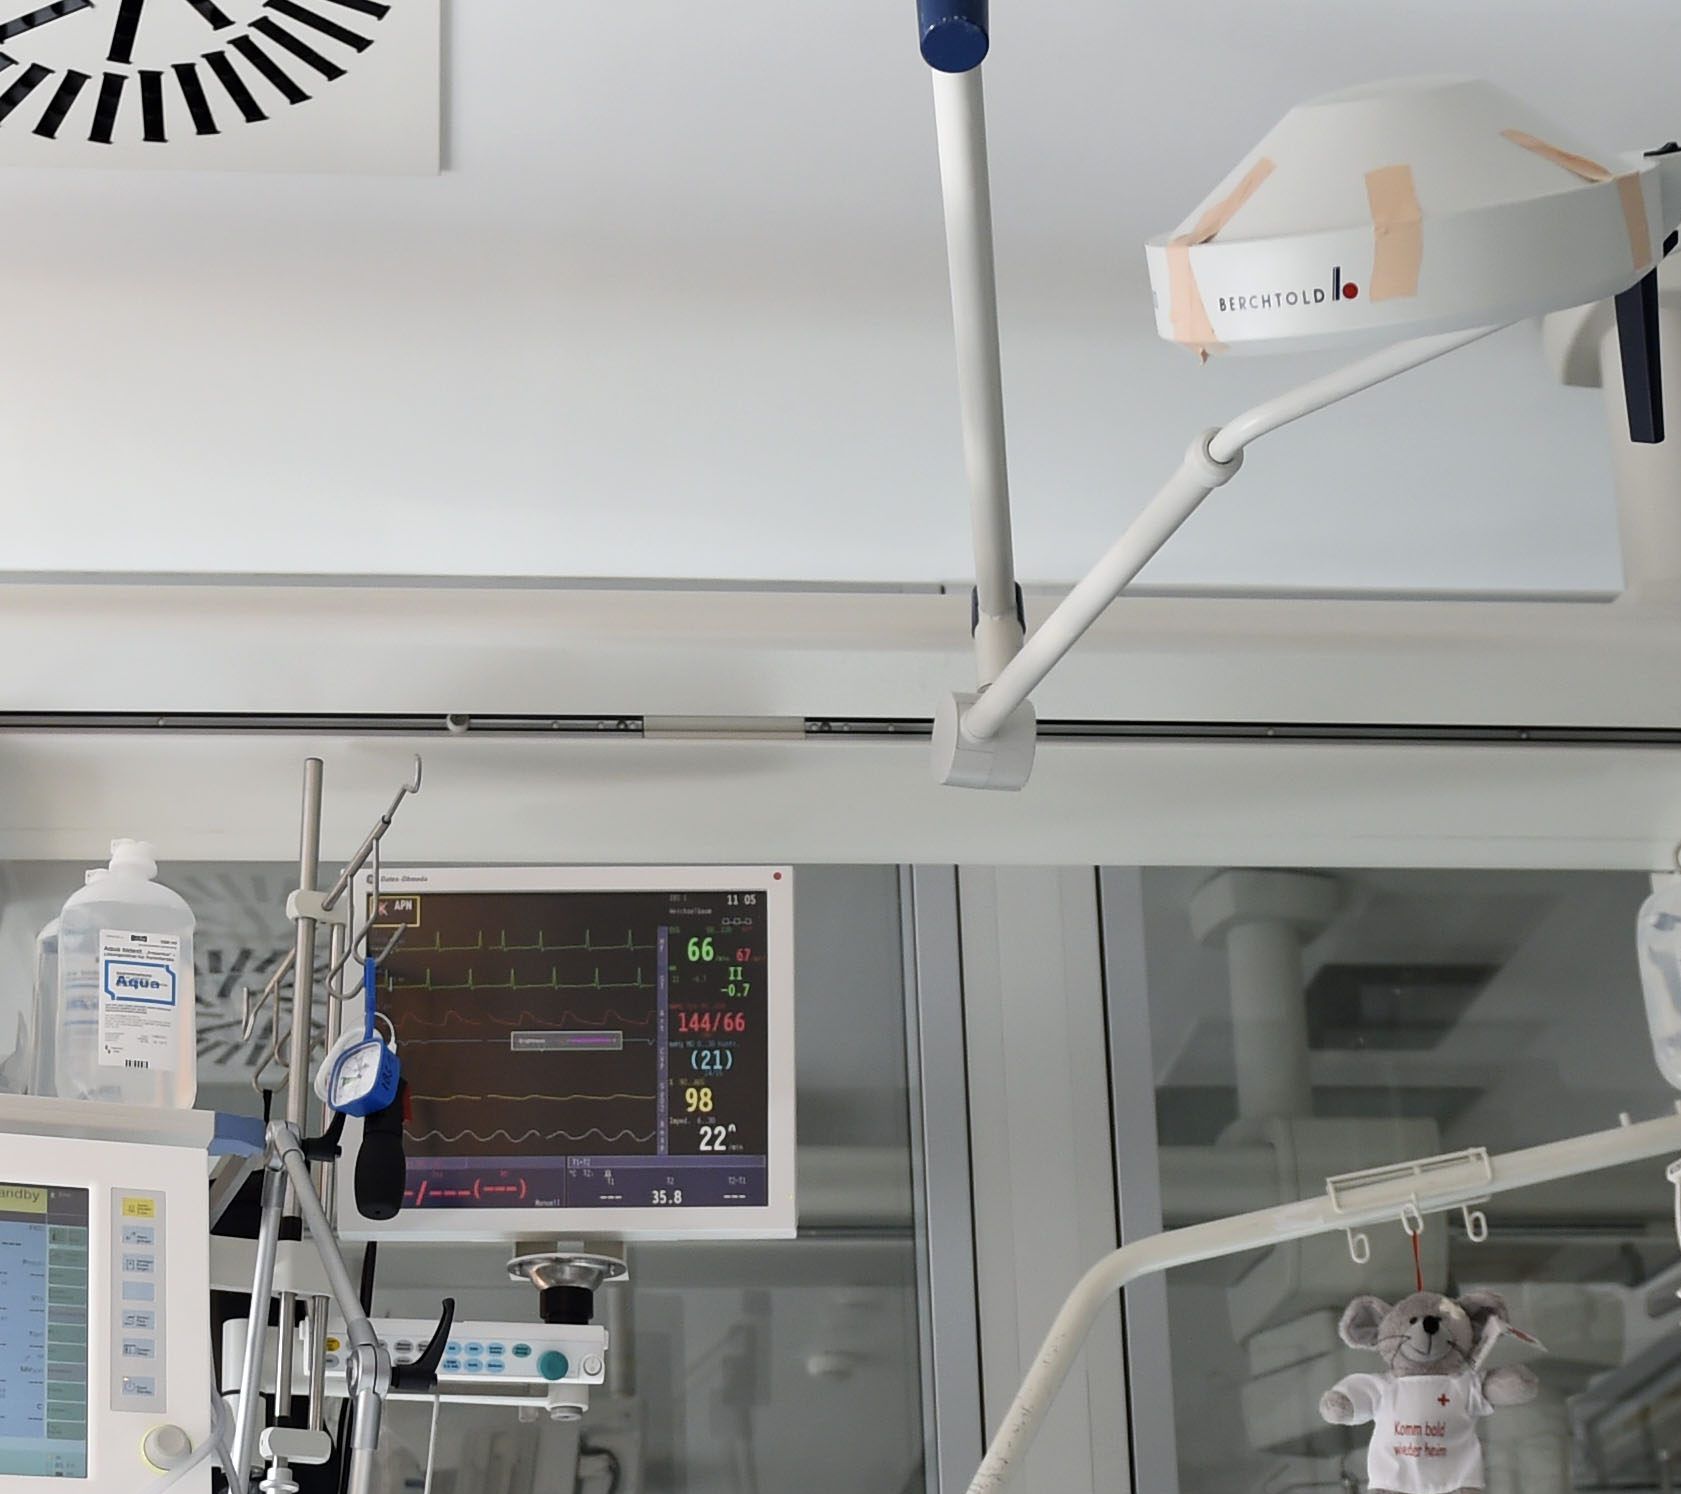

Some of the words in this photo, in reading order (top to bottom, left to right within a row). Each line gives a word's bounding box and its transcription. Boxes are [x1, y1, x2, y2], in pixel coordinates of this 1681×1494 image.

[1219, 288, 1325, 312] BERCHTOLD
[394, 899, 413, 911] APN
[687, 936, 714, 962] 66
[736, 948, 752, 962] 67
[116, 975, 160, 990] Aqua
[720, 983, 751, 997] -0.7
[678, 1012, 746, 1032] 144/66
[690, 1050, 733, 1070] (21)
[685, 1087, 713, 1112] 98
[699, 1125, 727, 1151] 22
[652, 1189, 683, 1204] 35.8
[1394, 1420, 1422, 1436] Komm
[1425, 1420, 1446, 1437] bald
